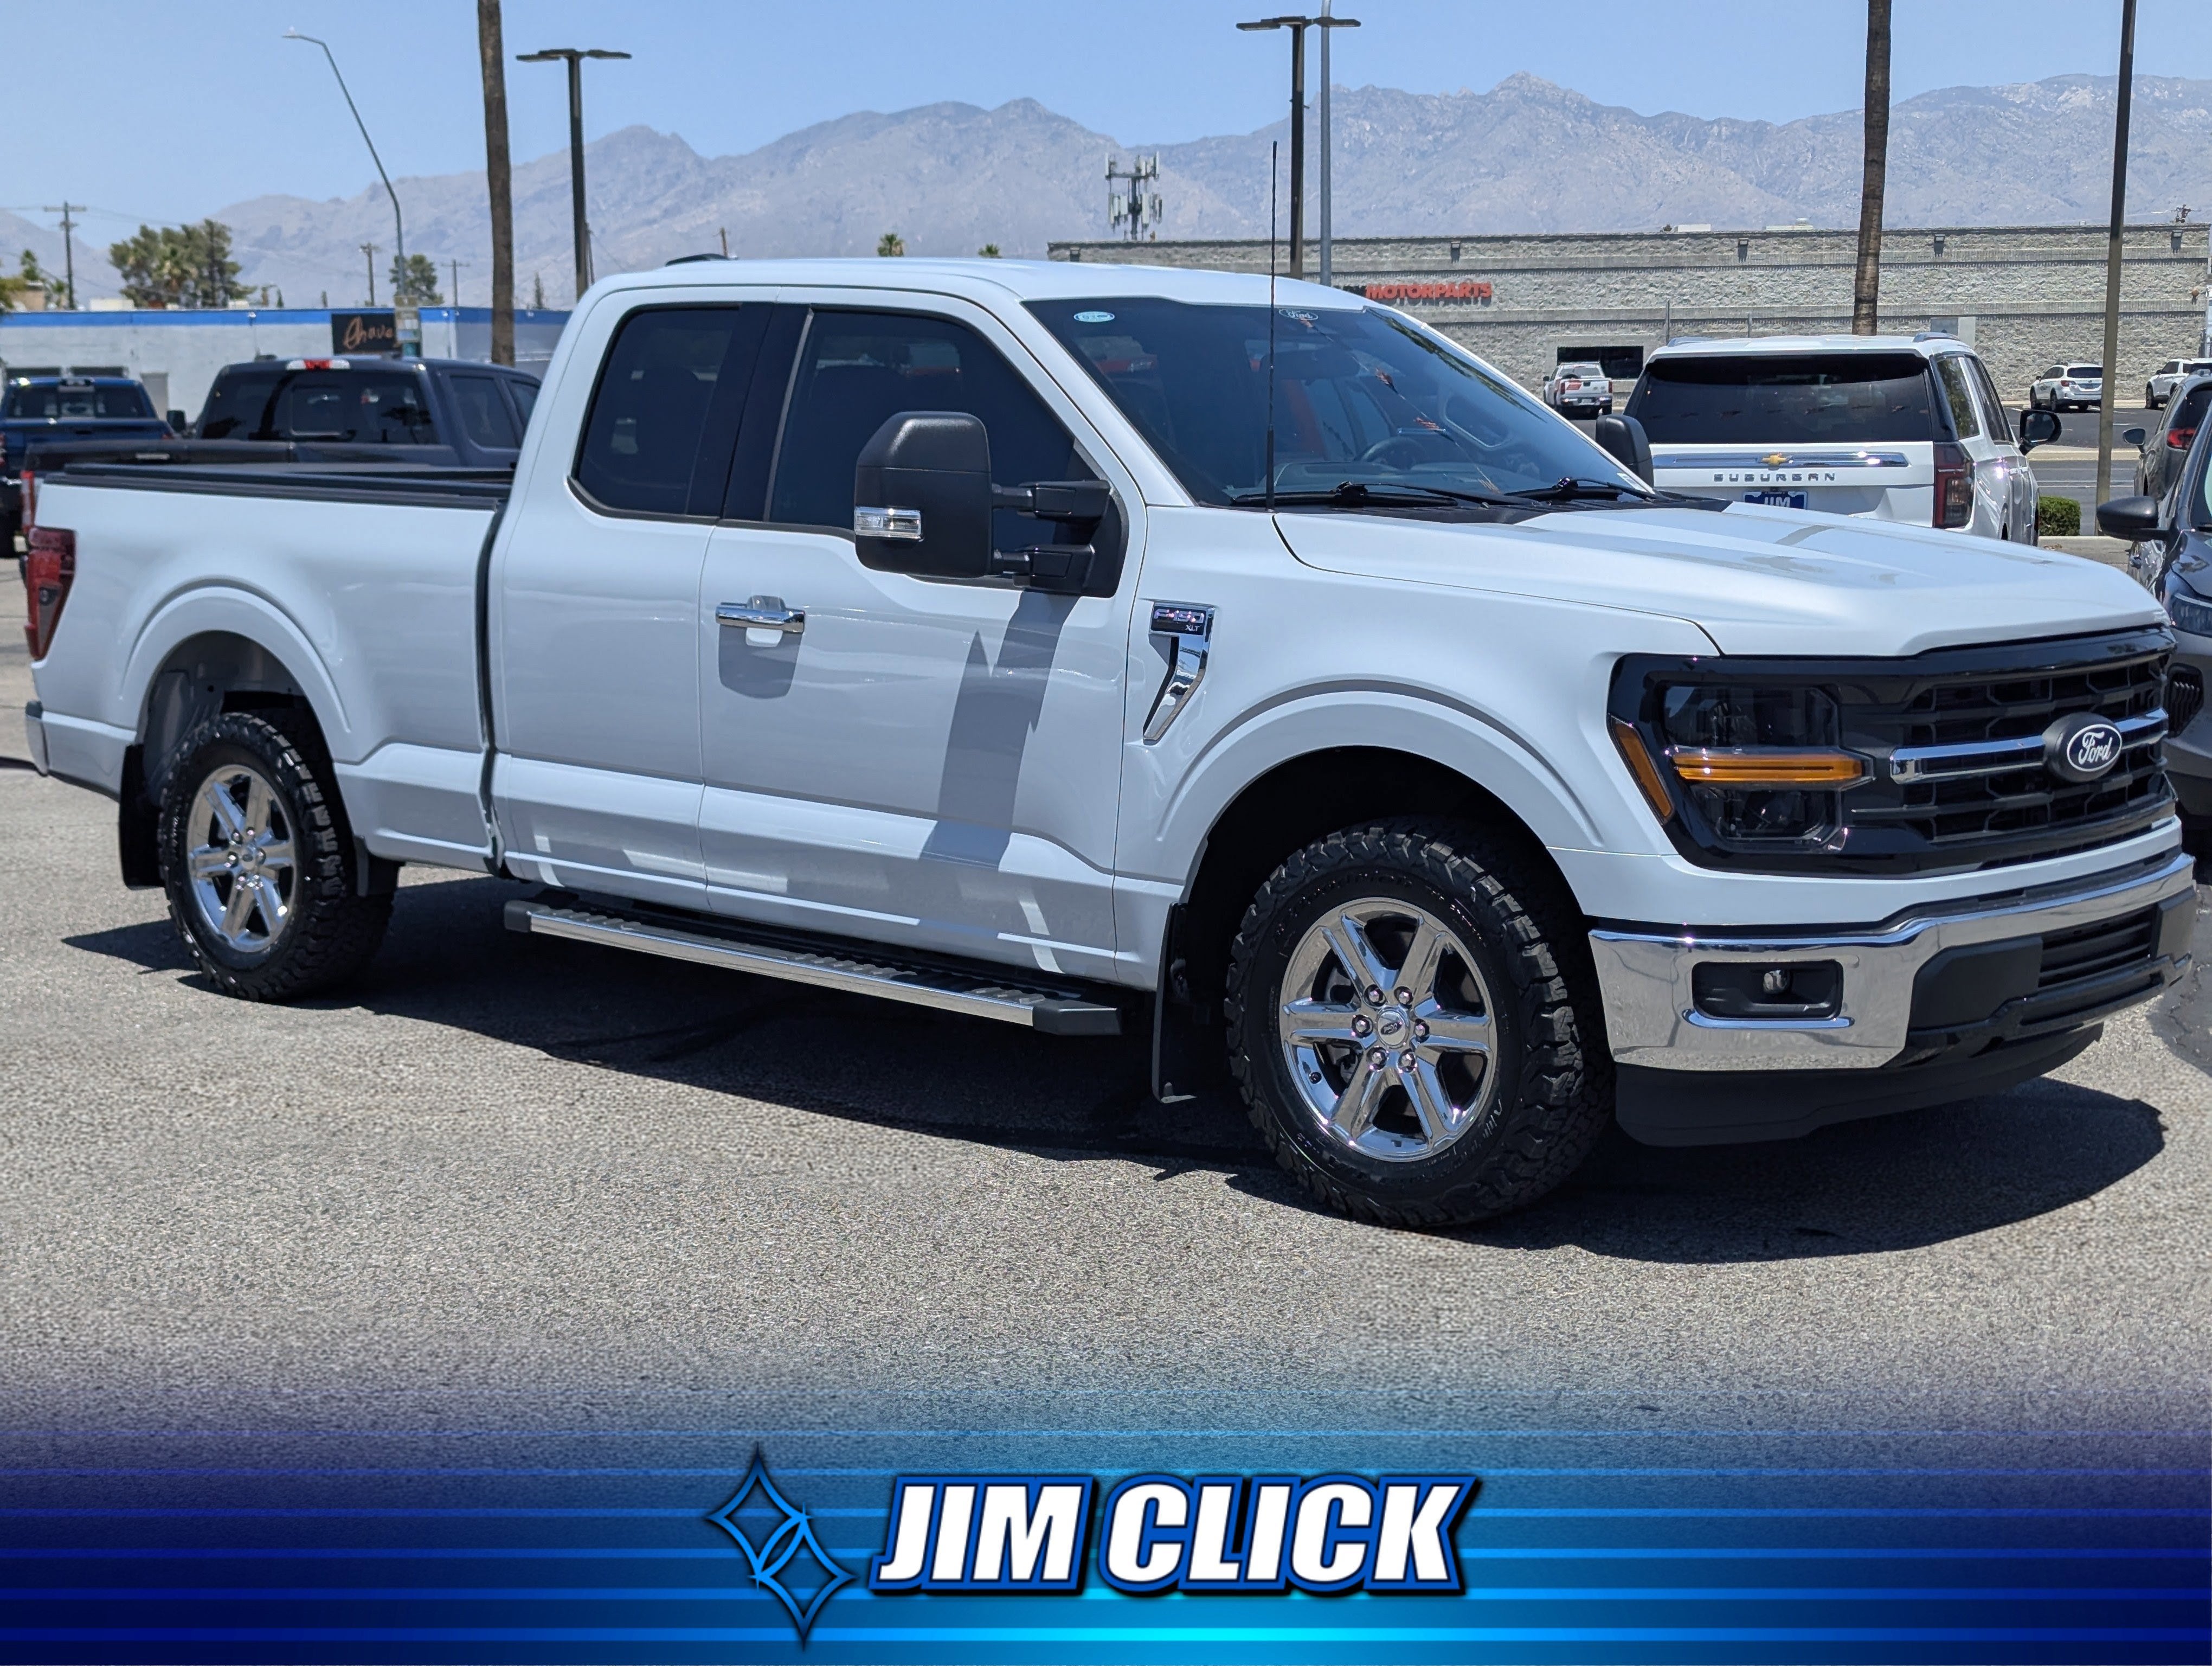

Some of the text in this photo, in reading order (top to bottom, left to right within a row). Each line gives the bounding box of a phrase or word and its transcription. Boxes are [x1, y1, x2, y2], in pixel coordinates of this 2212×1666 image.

[1366, 282, 1492, 299] MOTORPARTS
[1713, 472, 1835, 482] SUBURBAN
[1153, 608, 1205, 624] F-150
[2078, 731, 2113, 765] Ford
